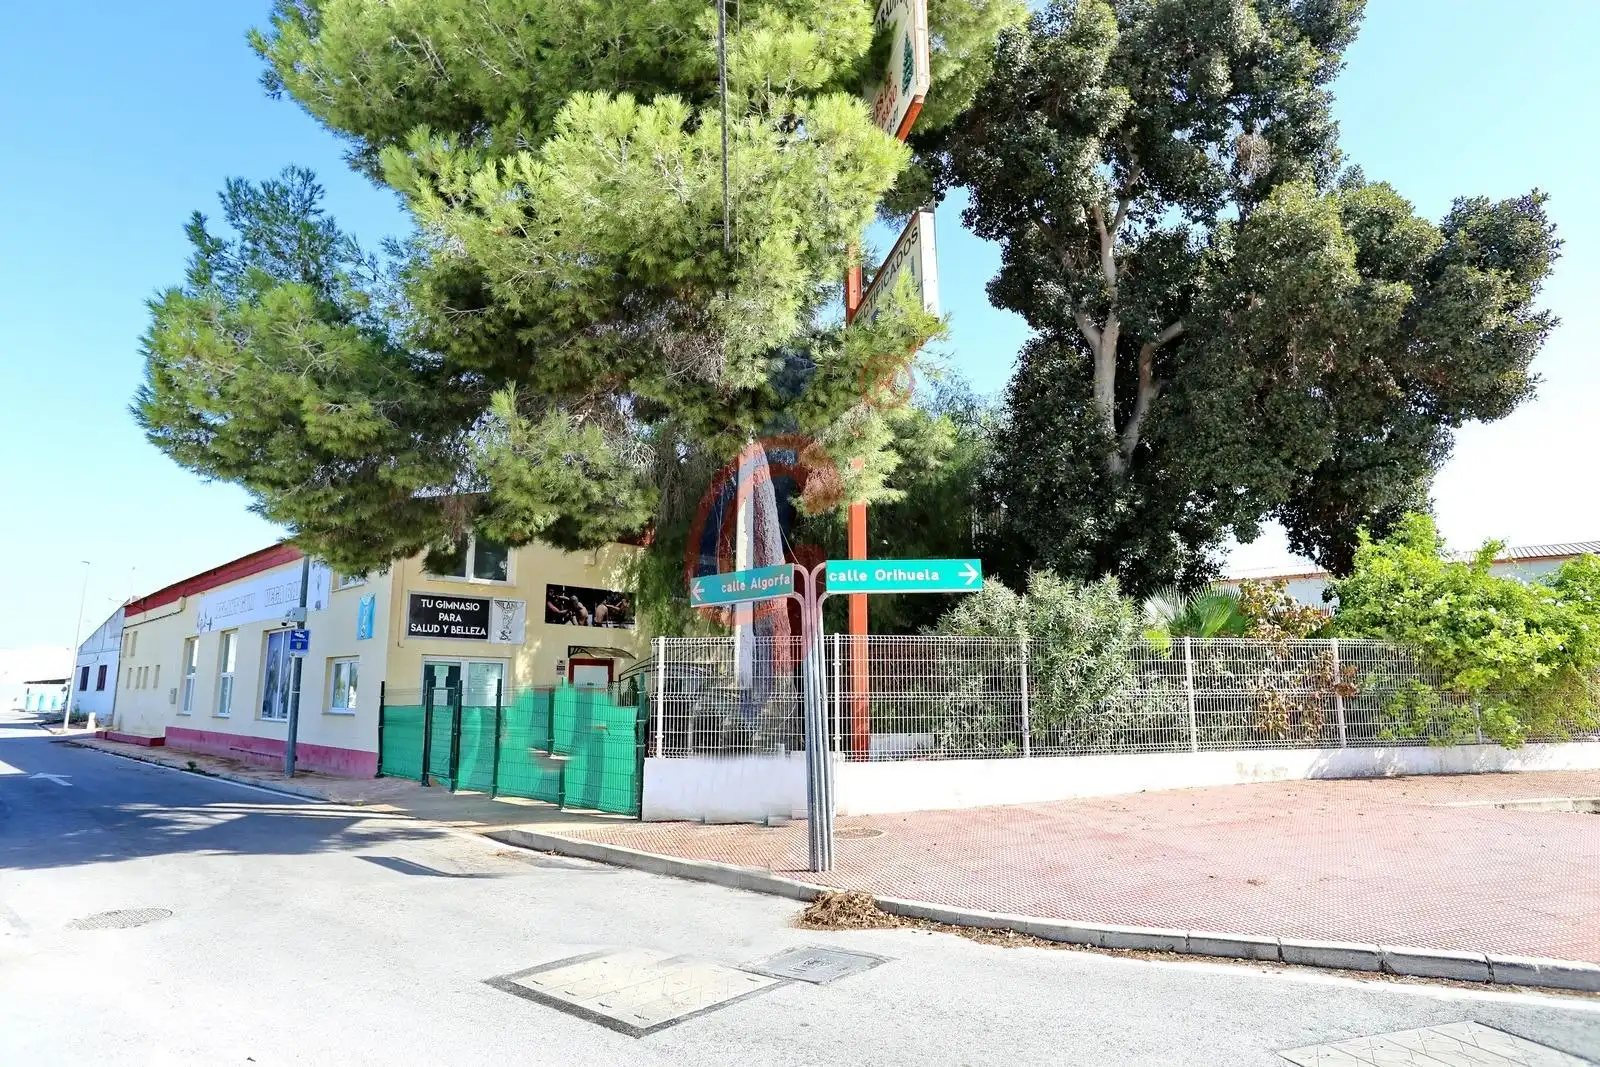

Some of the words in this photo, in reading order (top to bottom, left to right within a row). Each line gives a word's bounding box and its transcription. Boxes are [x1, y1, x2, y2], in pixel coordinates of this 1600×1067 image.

[854, 226, 919, 320] ECTIFICADOS
[828, 569, 868, 582] calle
[875, 568, 940, 581] Orihuela
[721, 580, 746, 593] calle
[750, 573, 791, 591] Algorfa
[421, 599, 434, 608] TU
[435, 600, 480, 611] GIMNASIO
[438, 612, 462, 622] PARA
[410, 623, 440, 633] SALUD
[442, 625, 450, 634] Y
[451, 626, 487, 636] BELLEZA
